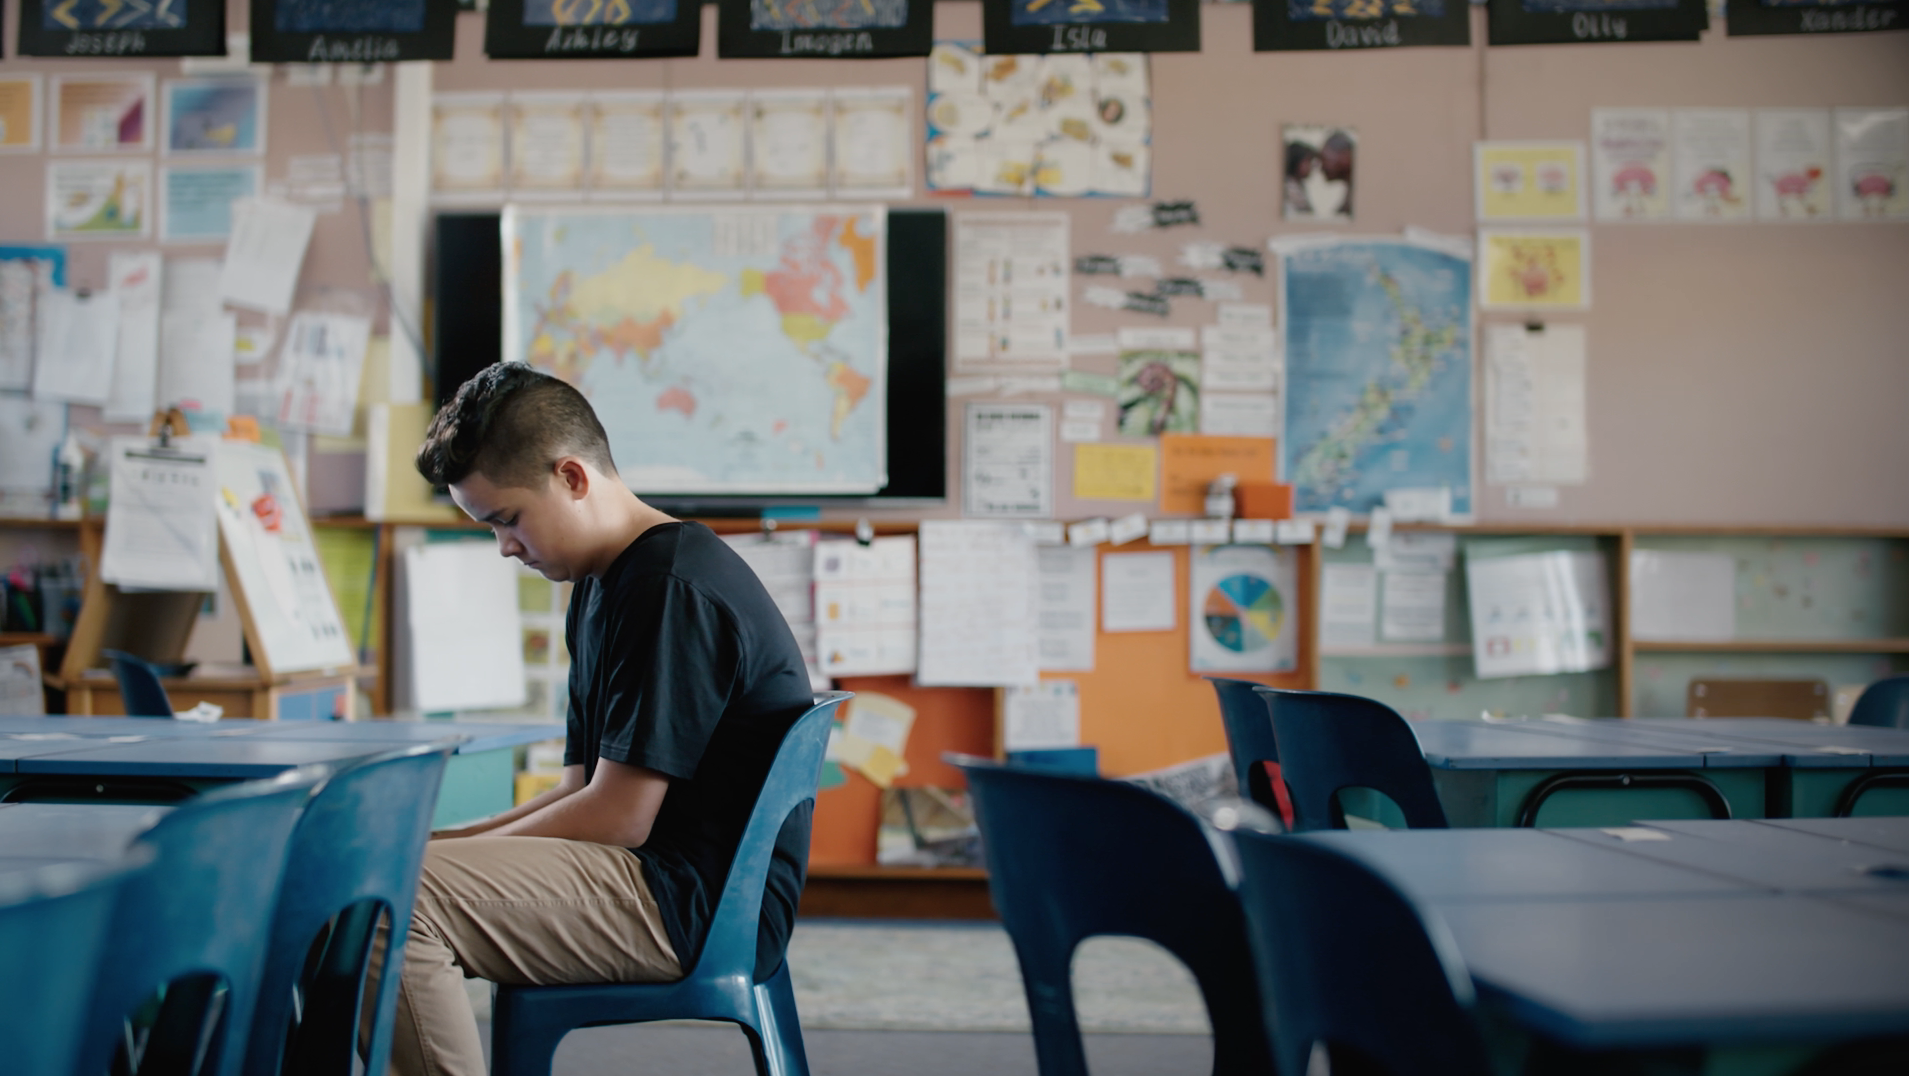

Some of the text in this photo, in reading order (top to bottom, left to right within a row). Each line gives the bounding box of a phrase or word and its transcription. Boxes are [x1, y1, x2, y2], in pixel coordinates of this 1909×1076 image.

[1572, 11, 1627, 39] Olly
[1800, 5, 1897, 31] Xander
[545, 26, 639, 52] Ashley
[779, 28, 873, 54] Imogen
[1050, 24, 1107, 50] Isla
[1326, 19, 1402, 48] David
[308, 34, 399, 60] Amelia
